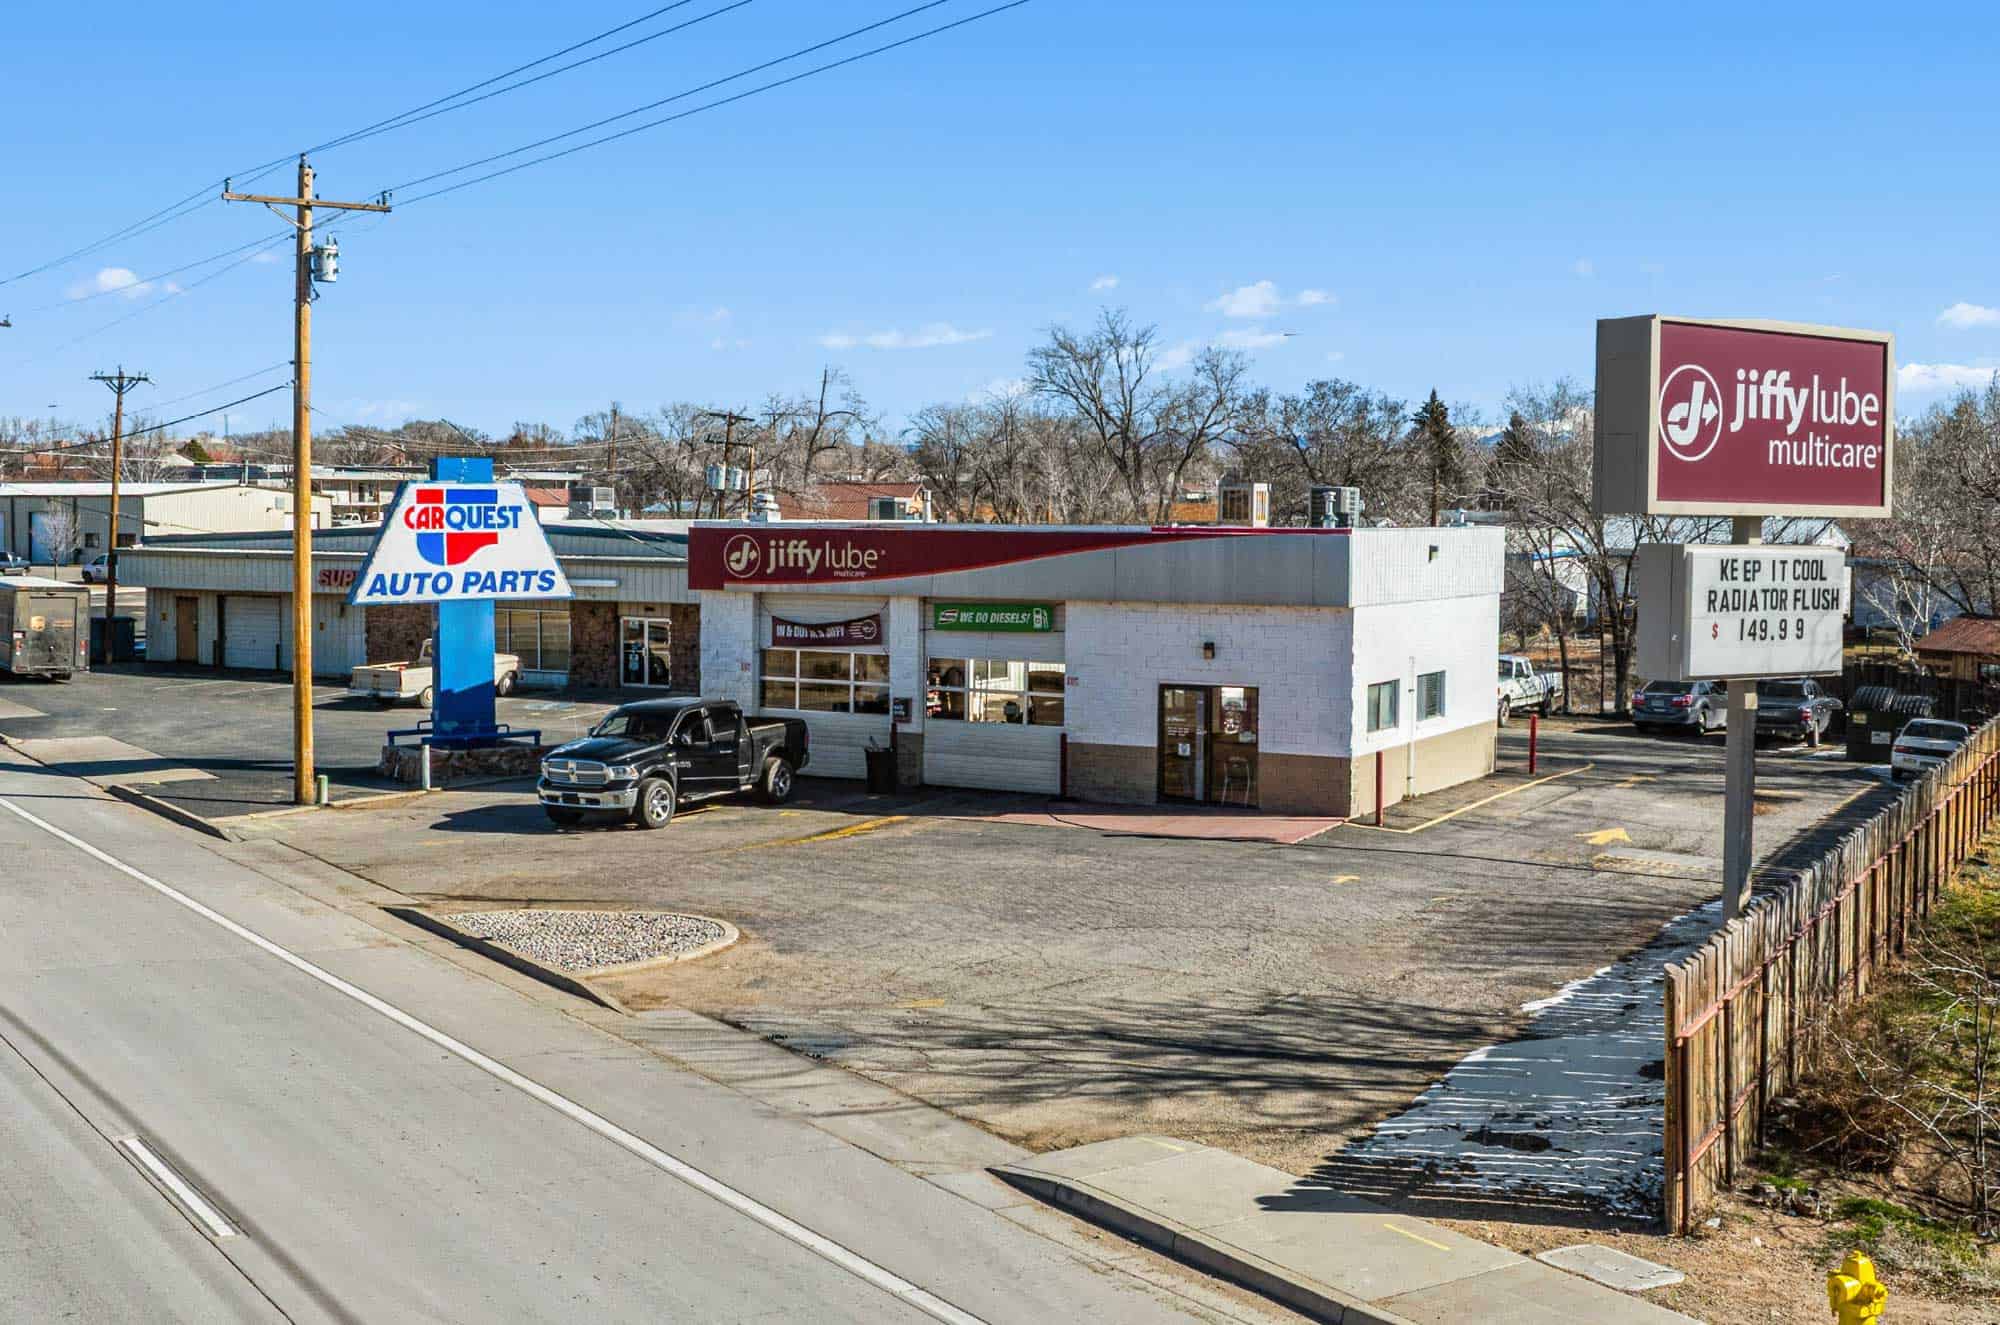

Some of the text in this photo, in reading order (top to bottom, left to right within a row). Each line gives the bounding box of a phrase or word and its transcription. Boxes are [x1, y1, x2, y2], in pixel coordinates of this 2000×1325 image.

[1730, 368, 1879, 435] jiffy lube
[1768, 431, 1879, 469] multicare
[403, 505, 523, 531] CARQUEST
[766, 539, 878, 574] jiffy lube
[318, 568, 358, 586] SUP
[366, 569, 556, 596] AUTO PARTS
[1719, 558, 1827, 582] KEEP IT COOL
[1707, 588, 1840, 612] RADIATOR FLUSH
[960, 611, 974, 623] WE
[976, 612, 989, 624] DO
[990, 612, 1031, 624] DIESELS!
